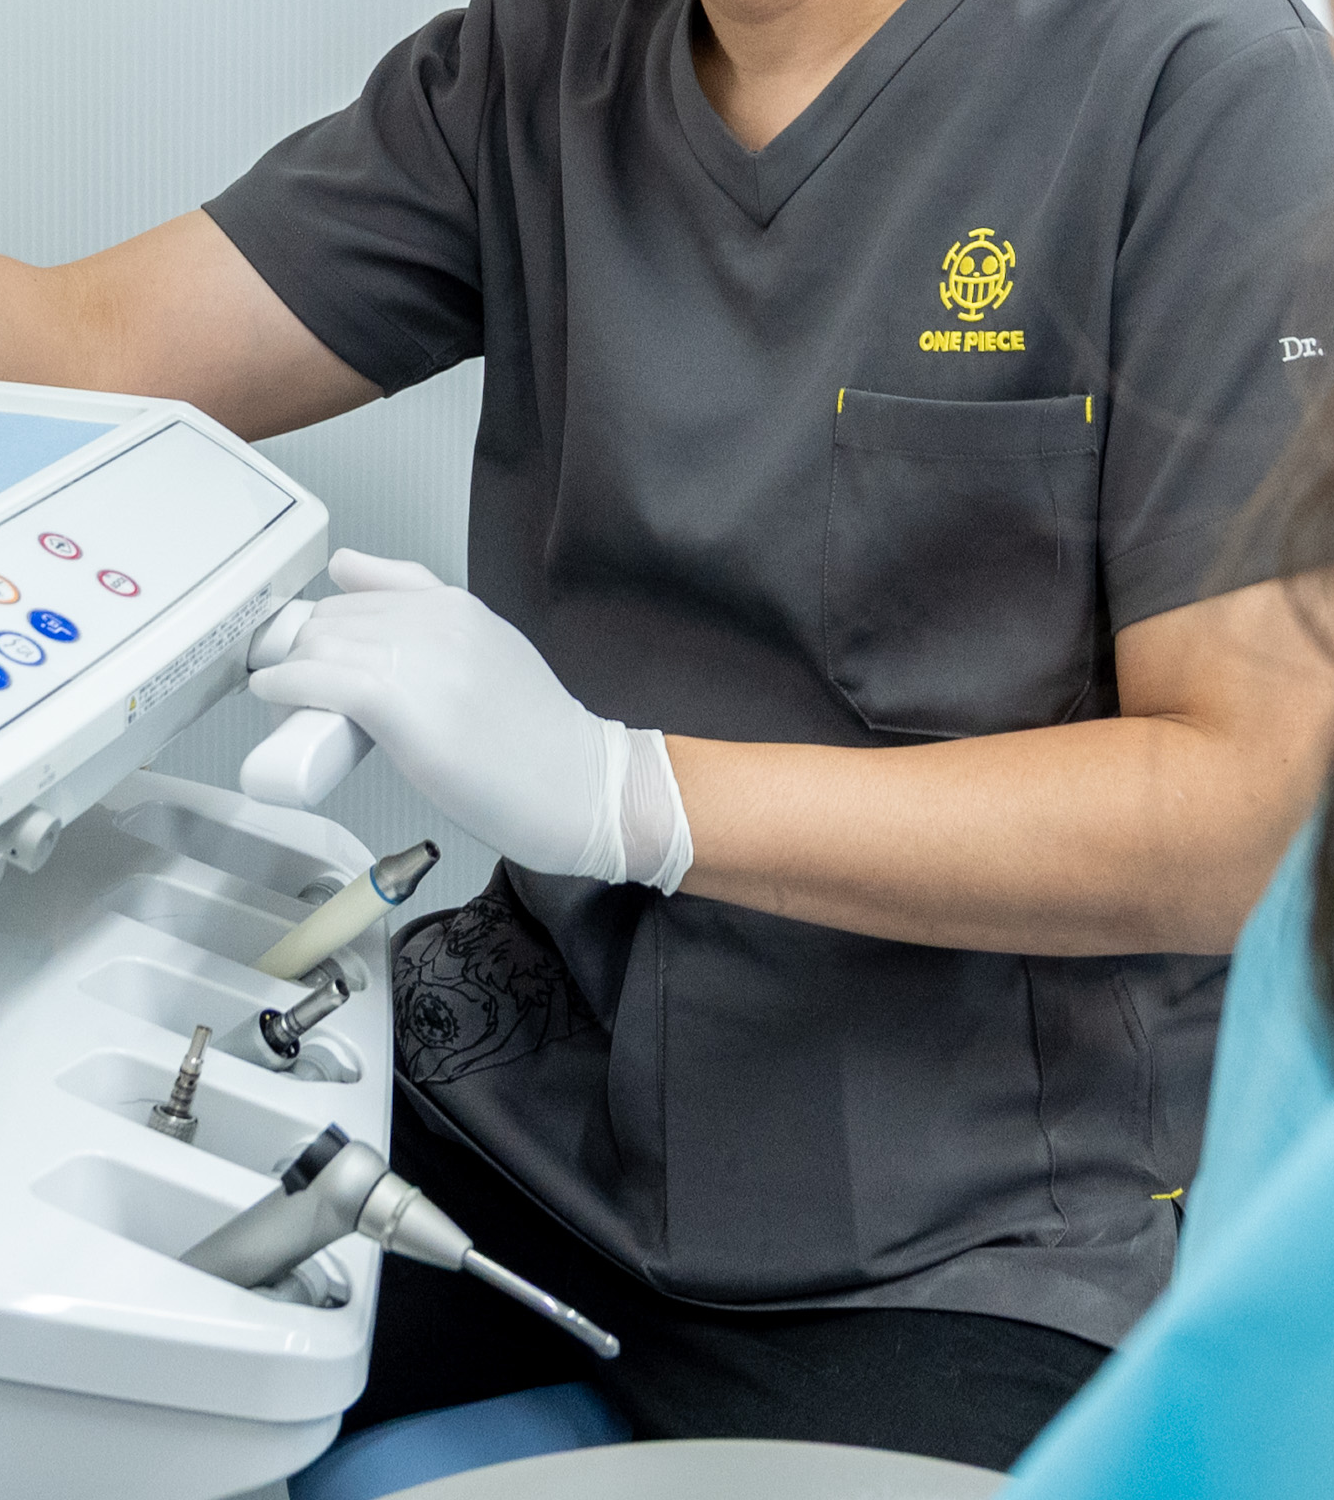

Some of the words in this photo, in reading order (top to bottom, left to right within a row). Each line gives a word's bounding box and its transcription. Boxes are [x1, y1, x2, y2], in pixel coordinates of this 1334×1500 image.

[919, 330, 962, 352] ONE
[963, 330, 1026, 352] PIECE
[1279, 336, 1324, 362] Dr.
